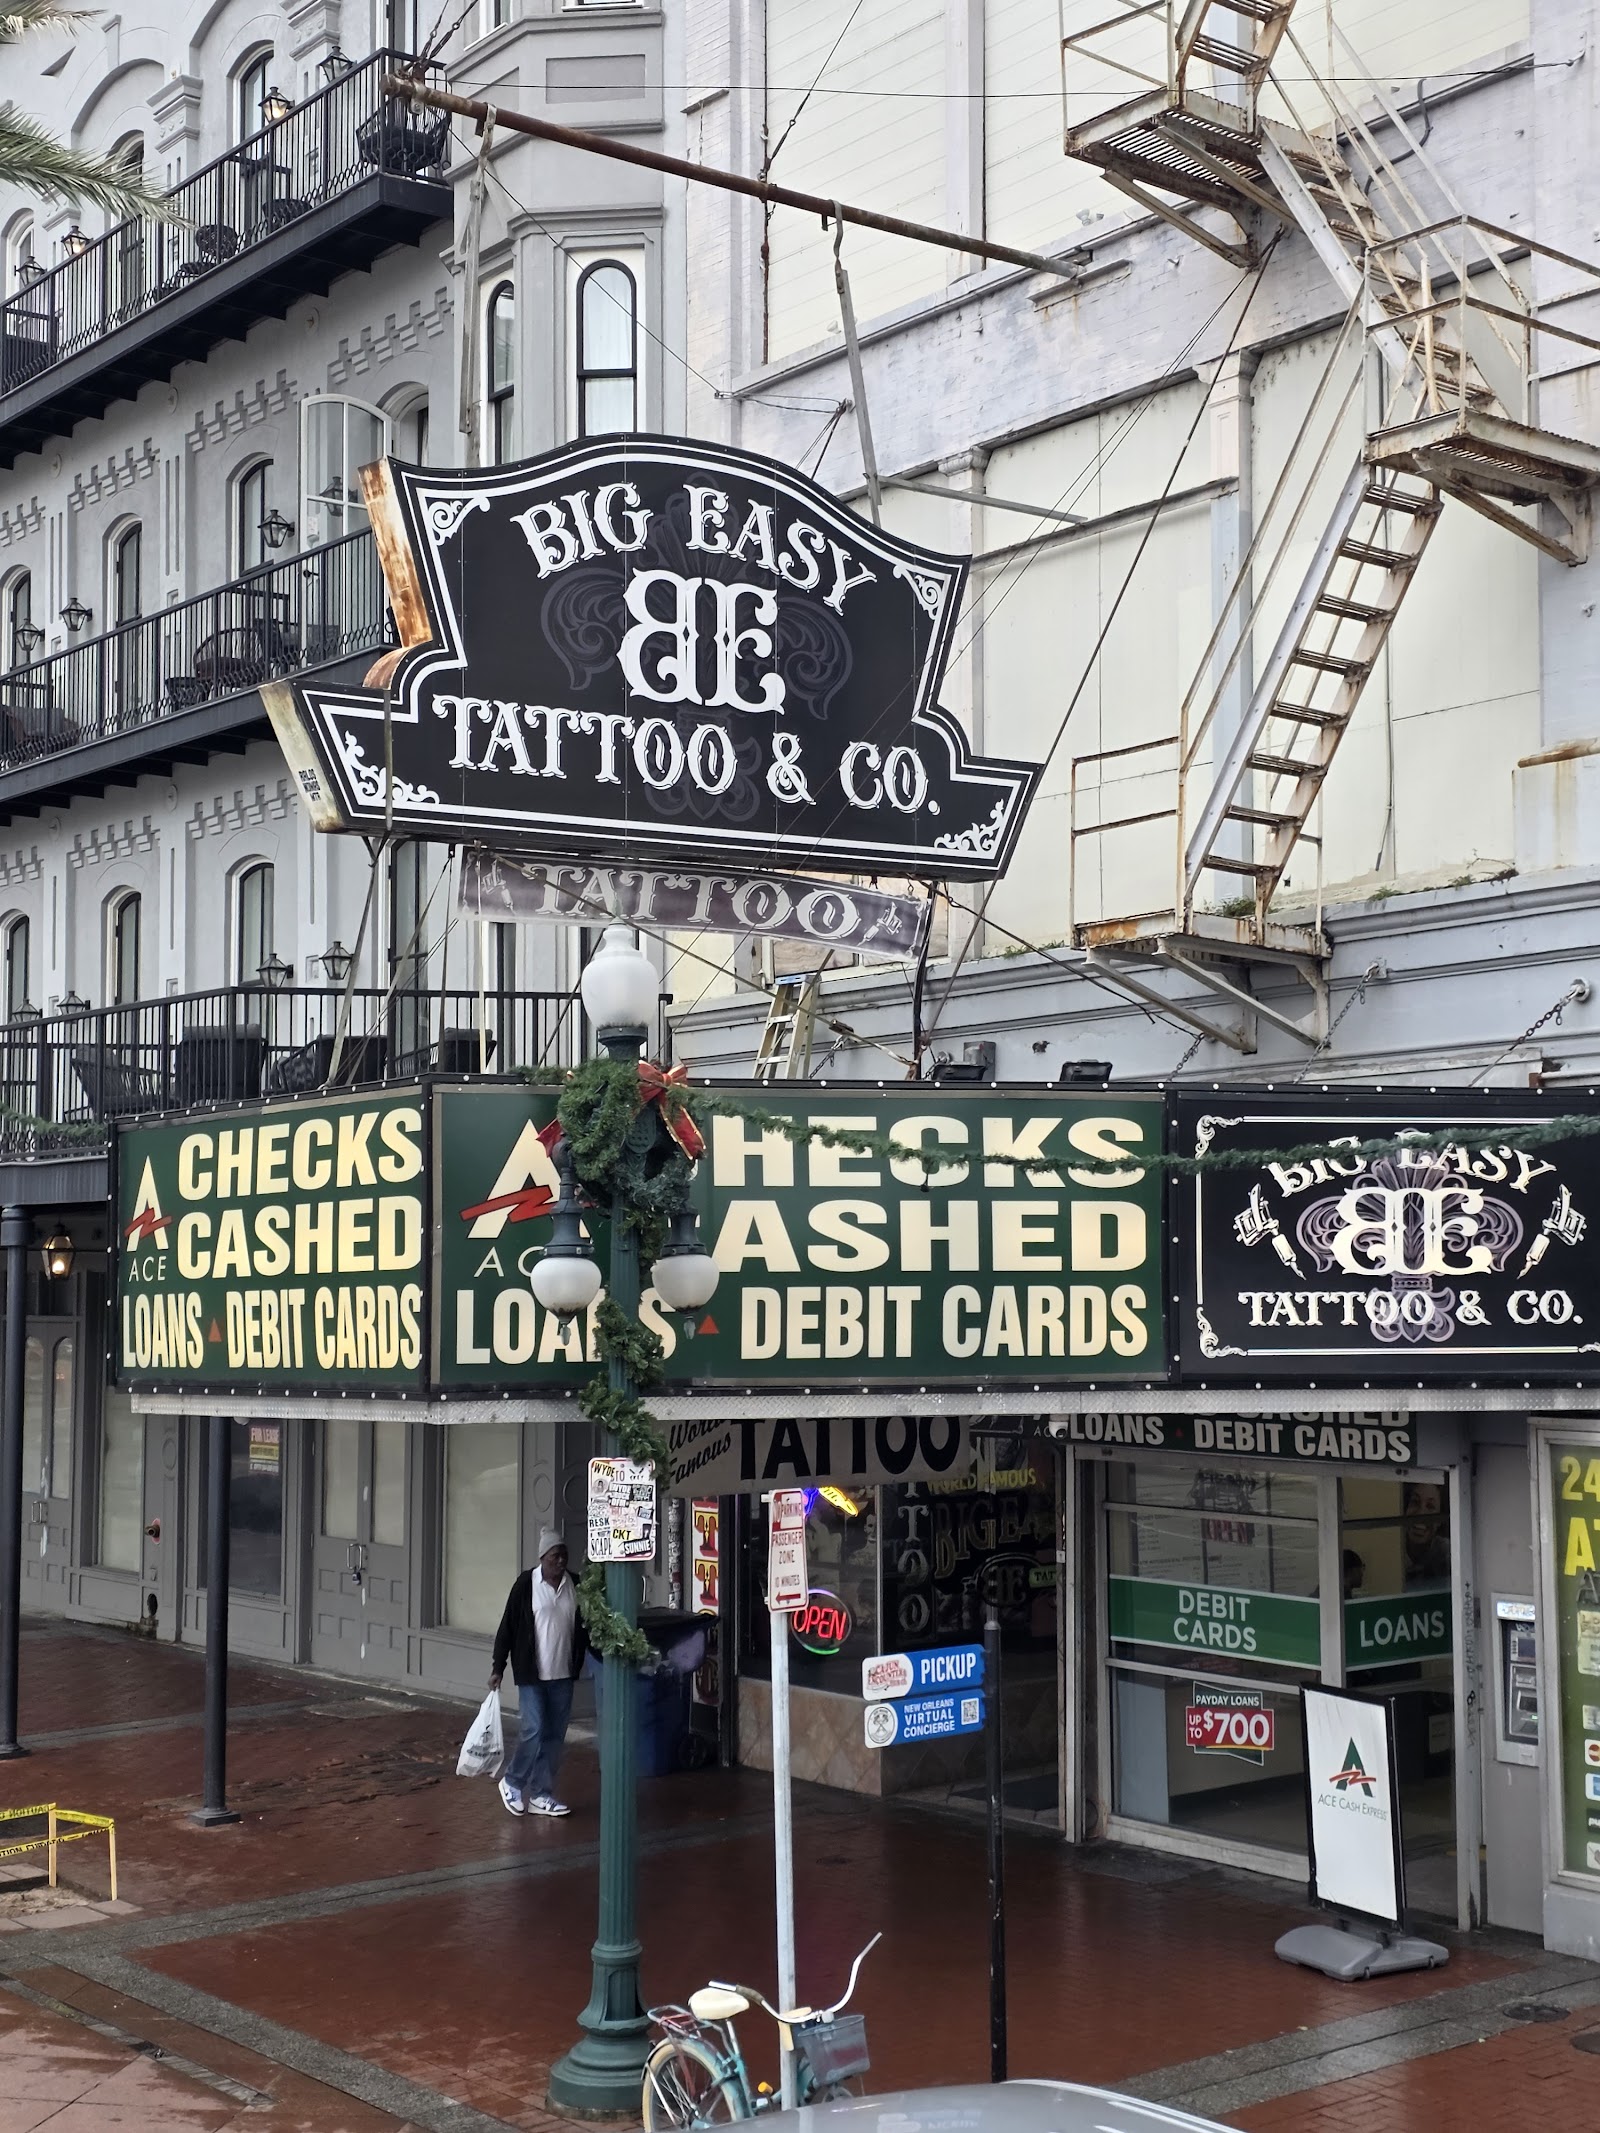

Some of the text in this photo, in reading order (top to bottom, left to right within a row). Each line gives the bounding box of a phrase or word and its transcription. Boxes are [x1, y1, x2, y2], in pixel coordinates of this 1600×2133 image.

[510, 482, 877, 616] BIG EASY
[432, 694, 942, 816] TATTOO & CO.
[520, 862, 864, 940] TATTOO
[178, 1107, 422, 1201] CHECKS
[692, 1115, 1147, 1188] HECKS
[178, 1195, 422, 1280] CASHED
[668, 1199, 1147, 1273] ASHED
[128, 1255, 167, 1283] ACE
[740, 1285, 922, 1360] DEBIT
[942, 1284, 1149, 1359] CARDS
[1238, 1289, 1584, 1327] TATTOO & CO.
[122, 1282, 422, 1371] LOANS DEBIT CARDS
[730, 1417, 961, 1481] TATTOO
[1069, 1413, 1165, 1446] LOANS
[1193, 1417, 1283, 1454] DEBIT
[1294, 1425, 1412, 1463] CARDS
[781, 1503, 802, 1519] PARKING
[772, 1530, 803, 1548] PASSENGER
[778, 1549, 796, 1565] ZONE
[794, 1605, 847, 1641] OPEN
[1178, 1589, 1251, 1622] DEBIT
[1173, 1617, 1257, 1652] CARDS
[1359, 1610, 1445, 1648] LOANS
[920, 1652, 977, 1685] PICKUP
[904, 1698, 955, 1714] NEW ORLEANS
[904, 1708, 955, 1726] VIRTUAL
[1195, 1694, 1260, 1707] PAYDAY LOANS
[903, 1720, 956, 1738] CONCIERGE
[1188, 1709, 1270, 1746] UP $700
[1188, 1727, 1203, 1739] TO
[1317, 1793, 1337, 1808] ACE
